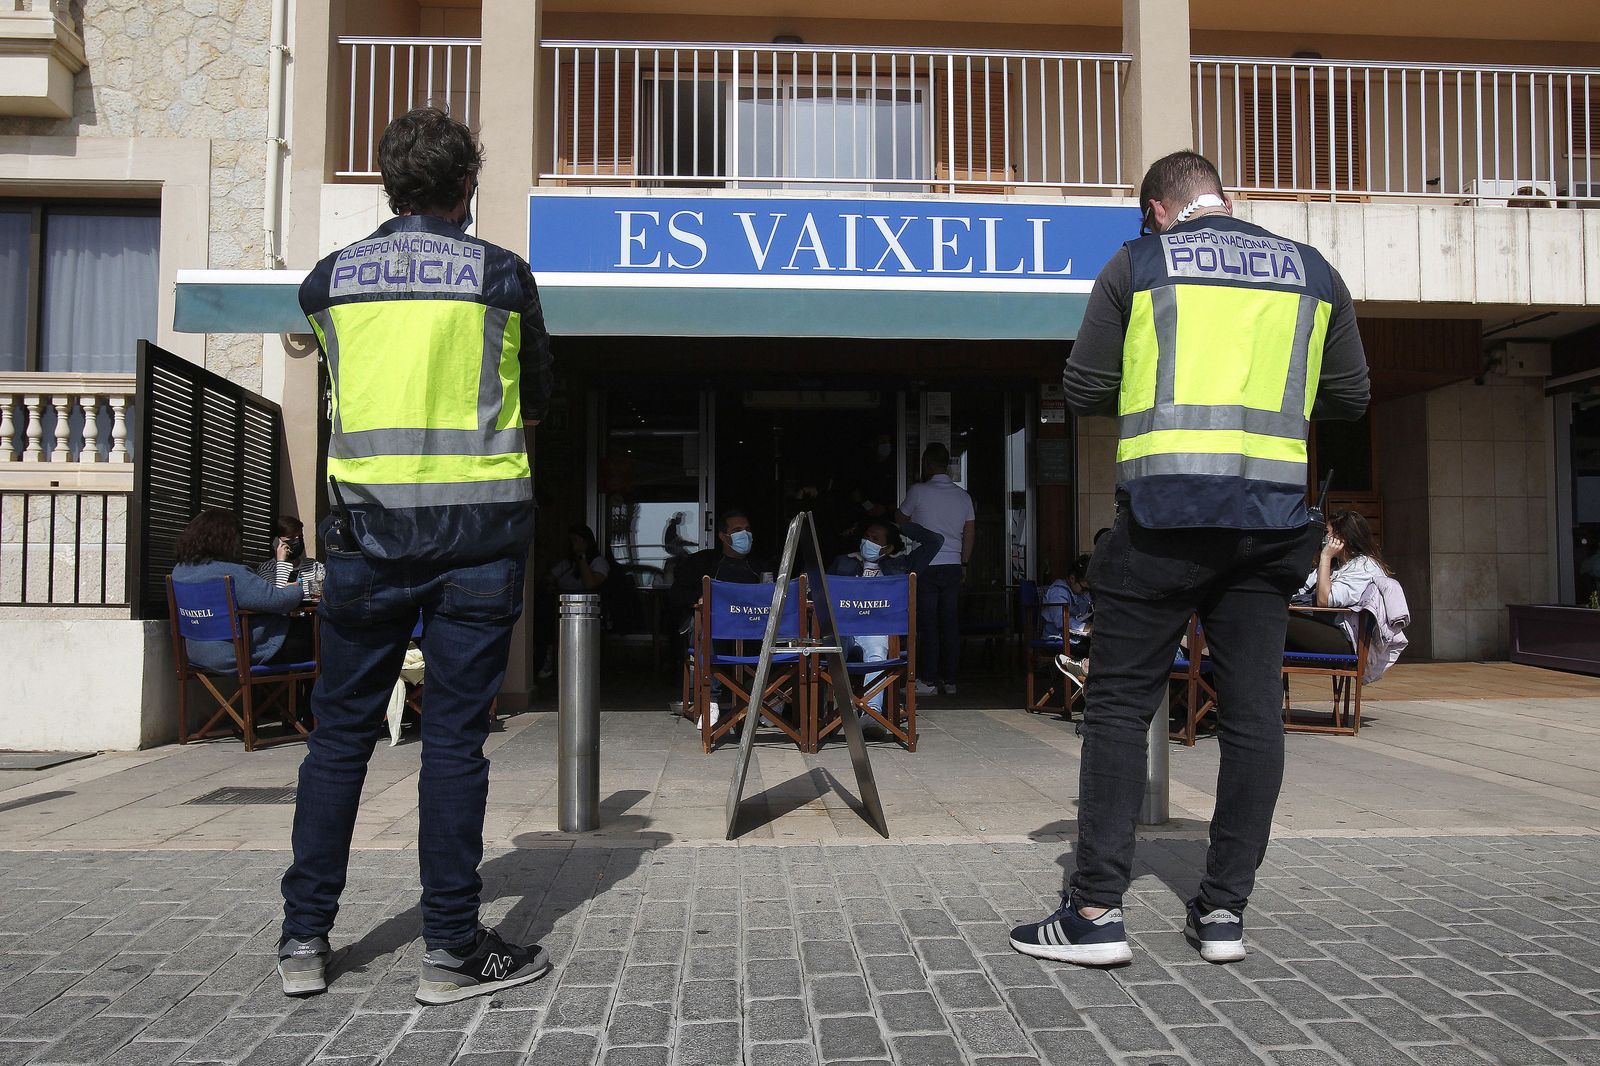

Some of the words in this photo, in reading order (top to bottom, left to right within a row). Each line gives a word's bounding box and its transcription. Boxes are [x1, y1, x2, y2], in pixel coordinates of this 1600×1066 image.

[339, 241, 389, 261] CUERPO
[392, 238, 460, 257] NACIONAL
[463, 246, 482, 260] DE
[614, 210, 707, 269] ES
[733, 212, 1072, 275] VAIXELL
[1167, 231, 1218, 245] CUERPO
[1219, 235, 1278, 251] NACIONAL
[1278, 243, 1296, 253] DE
[333, 258, 479, 289] POLICIA
[1169, 247, 1301, 280] POLICIA
[730, 604, 741, 613] ES
[839, 599, 851, 608] ES
[852, 600, 890, 609] VAIXELL
